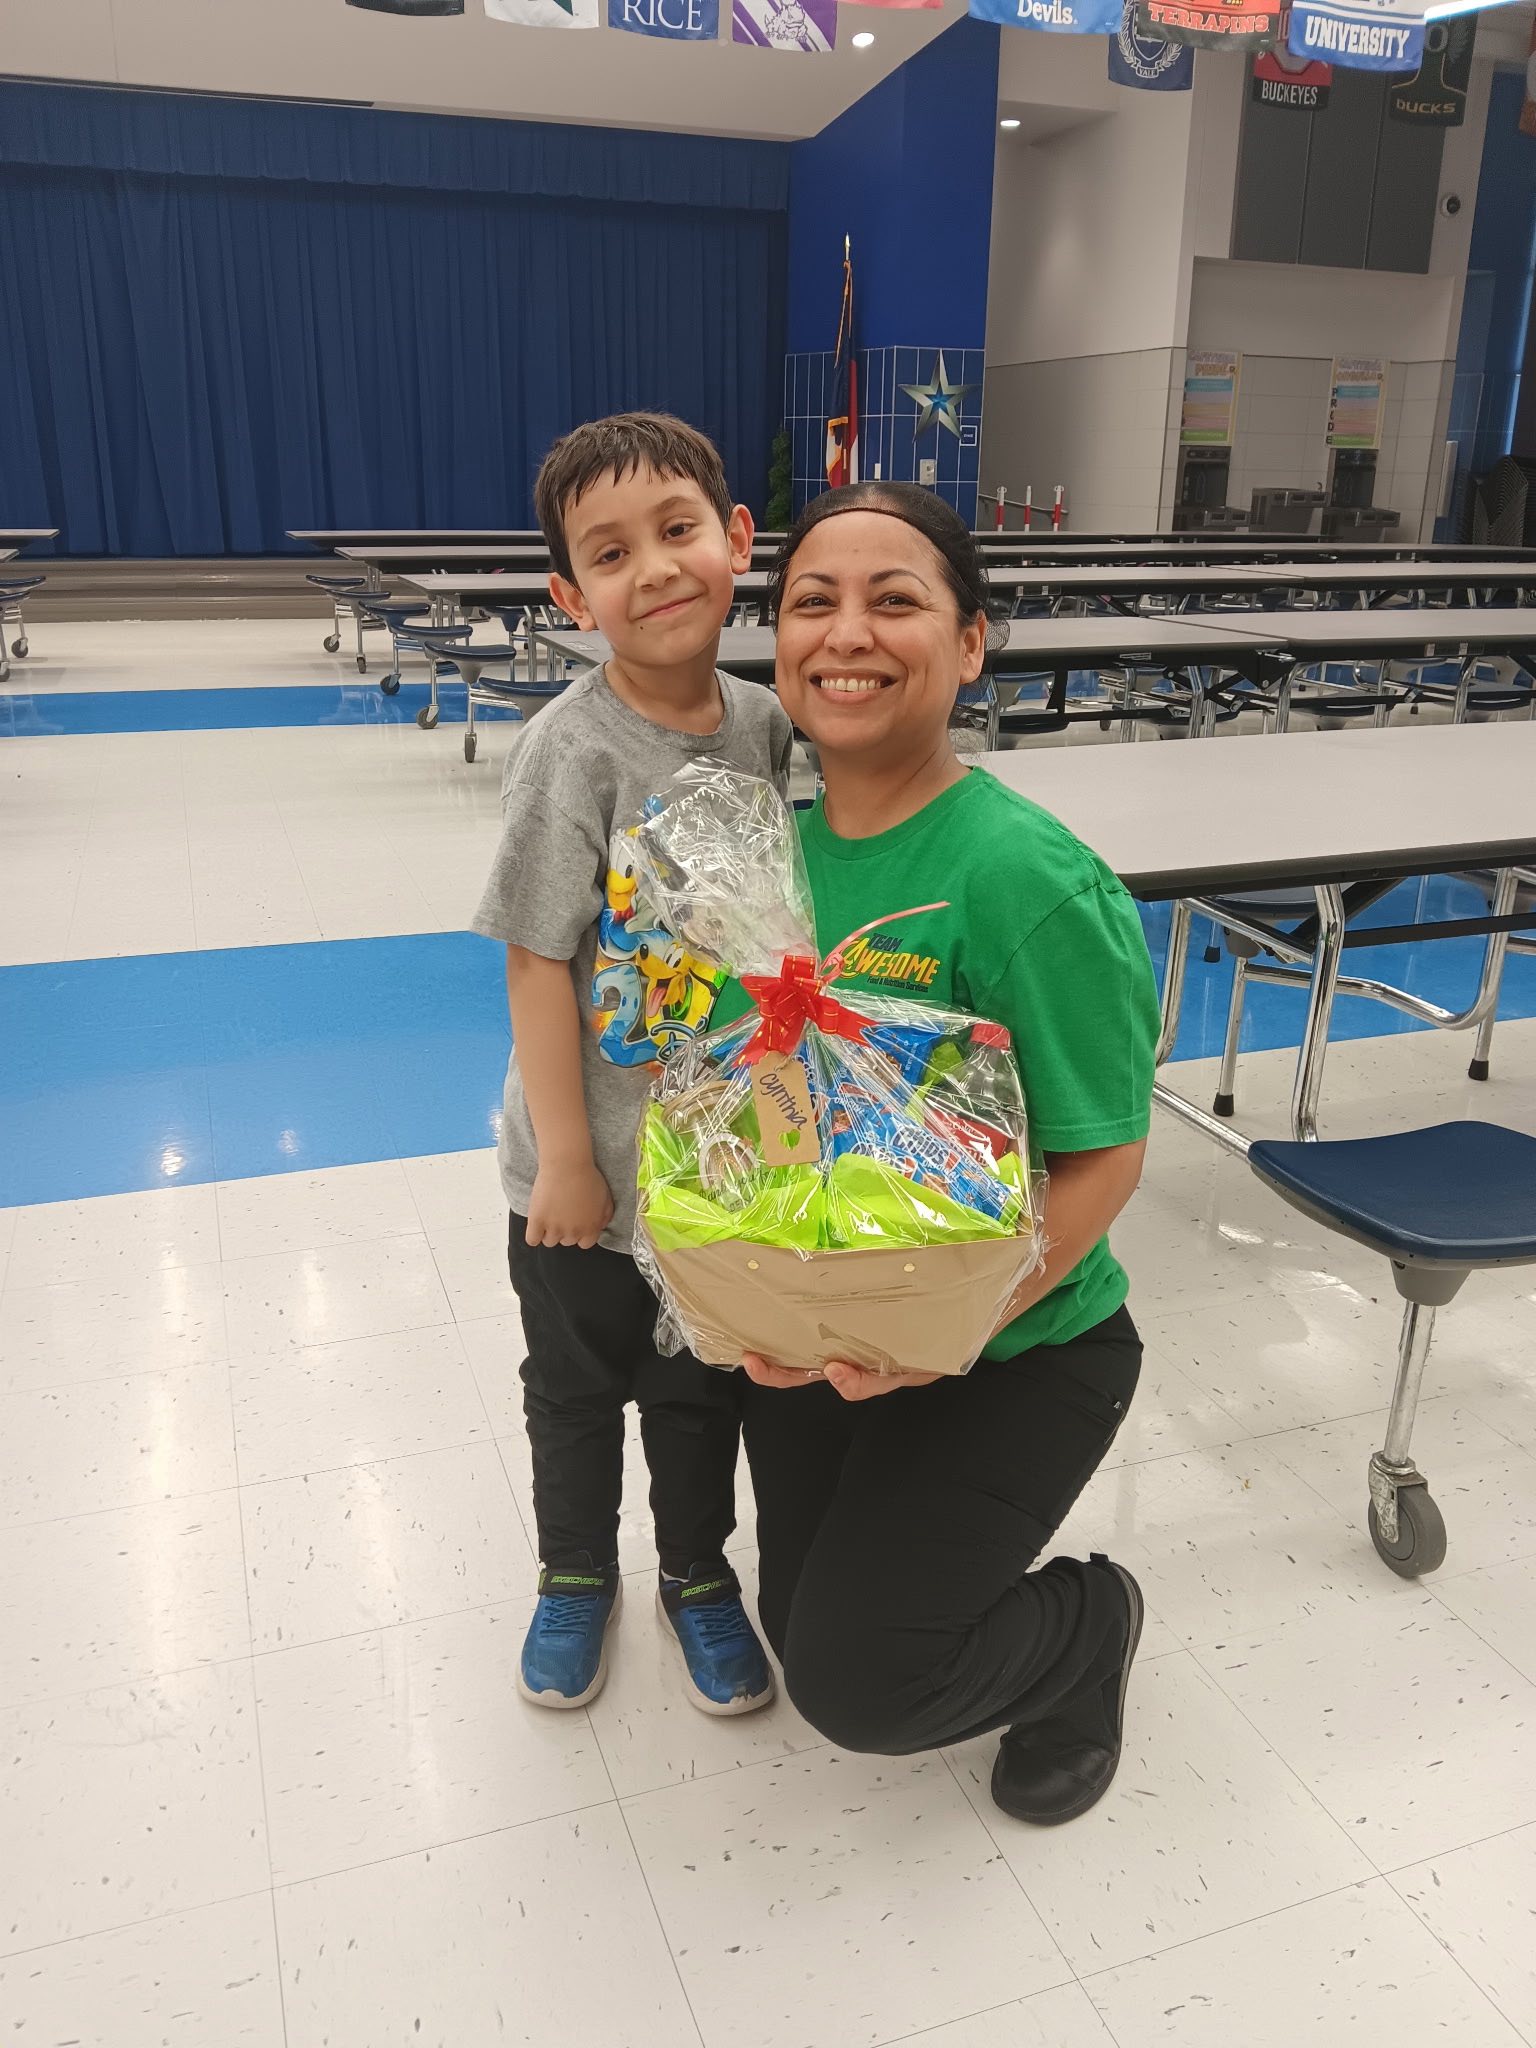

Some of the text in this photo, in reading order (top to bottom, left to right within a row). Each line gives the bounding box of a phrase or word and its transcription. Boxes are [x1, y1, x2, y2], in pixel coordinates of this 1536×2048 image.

[622, 0, 703, 30] RICE
[1148, 3, 1269, 34] TERRAPINS
[1304, 15, 1410, 58] UNIVERSITY
[1138, 68, 1156, 77] YALE
[1262, 80, 1318, 105] BUCKEYES
[1396, 99, 1456, 115] DUCKS
[868, 933, 904, 952] TEAM
[843, 938, 941, 984] AWESOME
